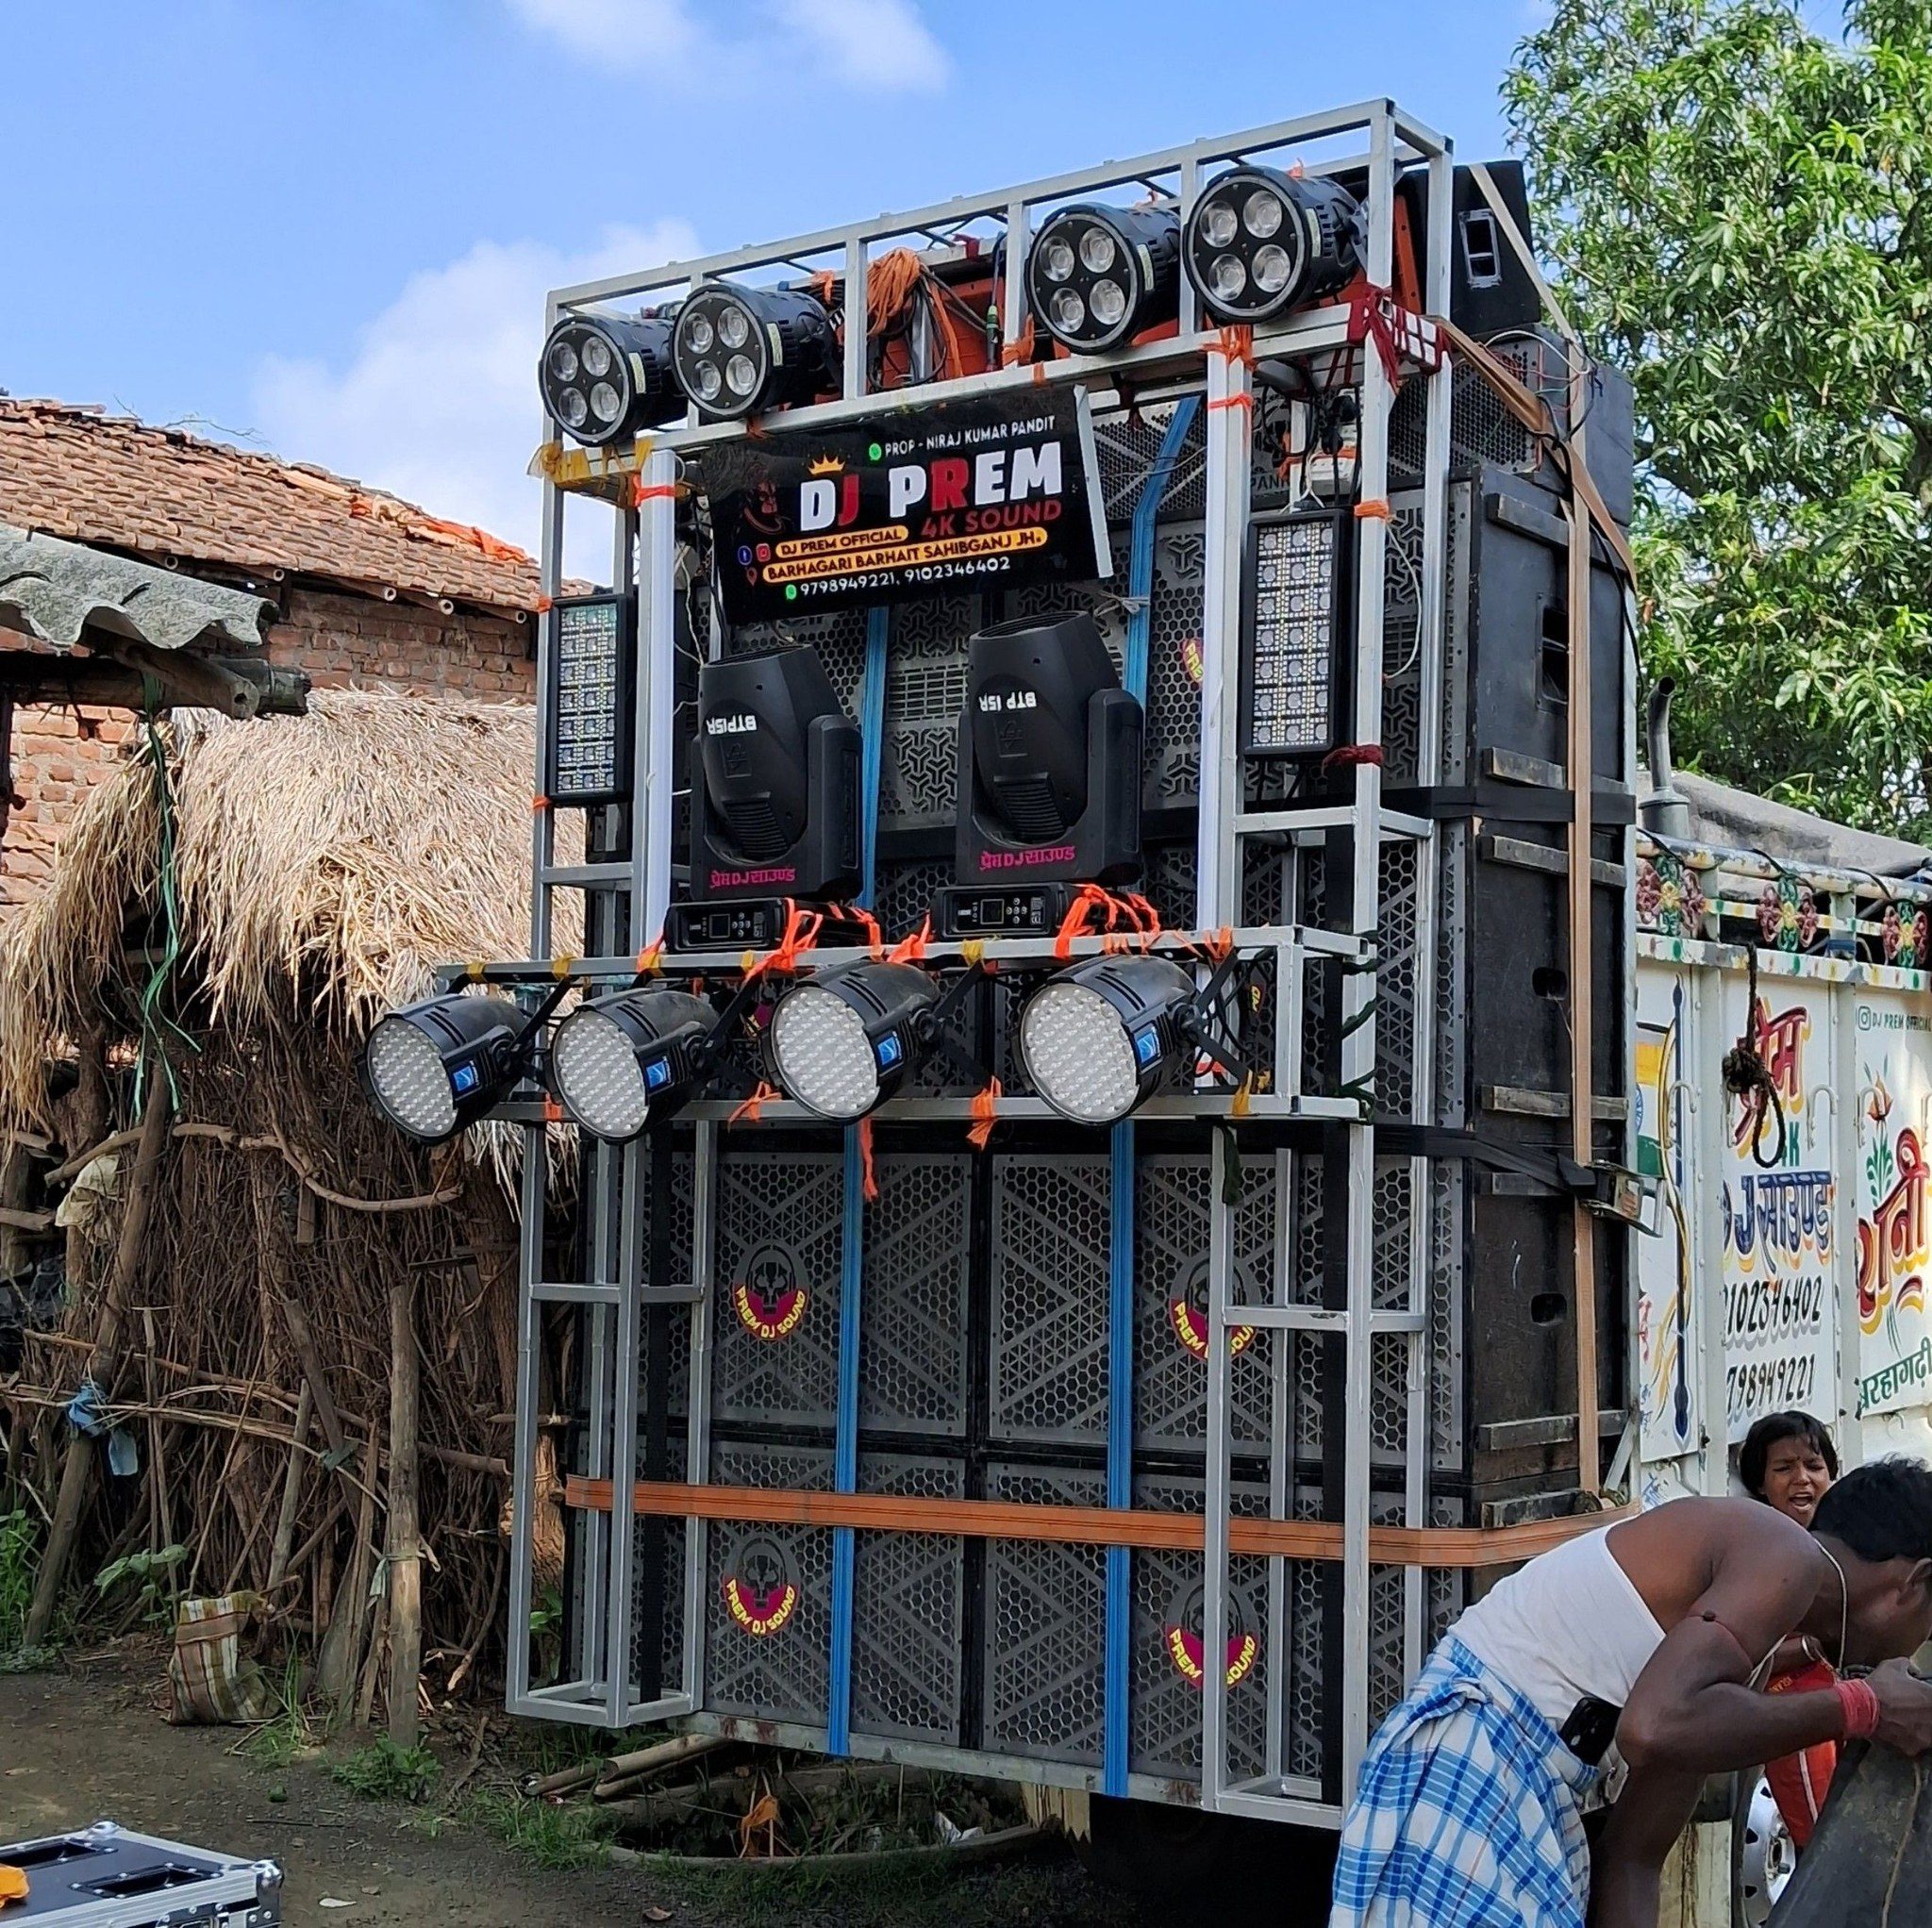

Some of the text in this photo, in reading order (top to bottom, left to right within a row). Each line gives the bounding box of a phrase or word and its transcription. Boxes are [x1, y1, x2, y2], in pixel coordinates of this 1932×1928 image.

[885, 440, 915, 457] PROP
[926, 434, 961, 451] NIRAJ
[965, 424, 1008, 444] KUMAR
[1011, 416, 1055, 436] PANDIT
[801, 441, 1062, 531] DJ PREM
[921, 500, 1062, 538] 4K SOUND
[768, 557, 853, 580] BARHAGARI
[856, 548, 920, 568] BARHAIT
[924, 535, 1011, 558] SAHIBGANJ
[781, 531, 902, 556] DJ PREM OFFICIAL
[905, 557, 1010, 582] 9102346402
[736, 1285, 806, 1338] PREM DJ SOUND
[1174, 1302, 1206, 1351] PREM
[726, 1578, 795, 1634] PREM DJ SOUND
[1170, 1628, 1203, 1679] PREM
